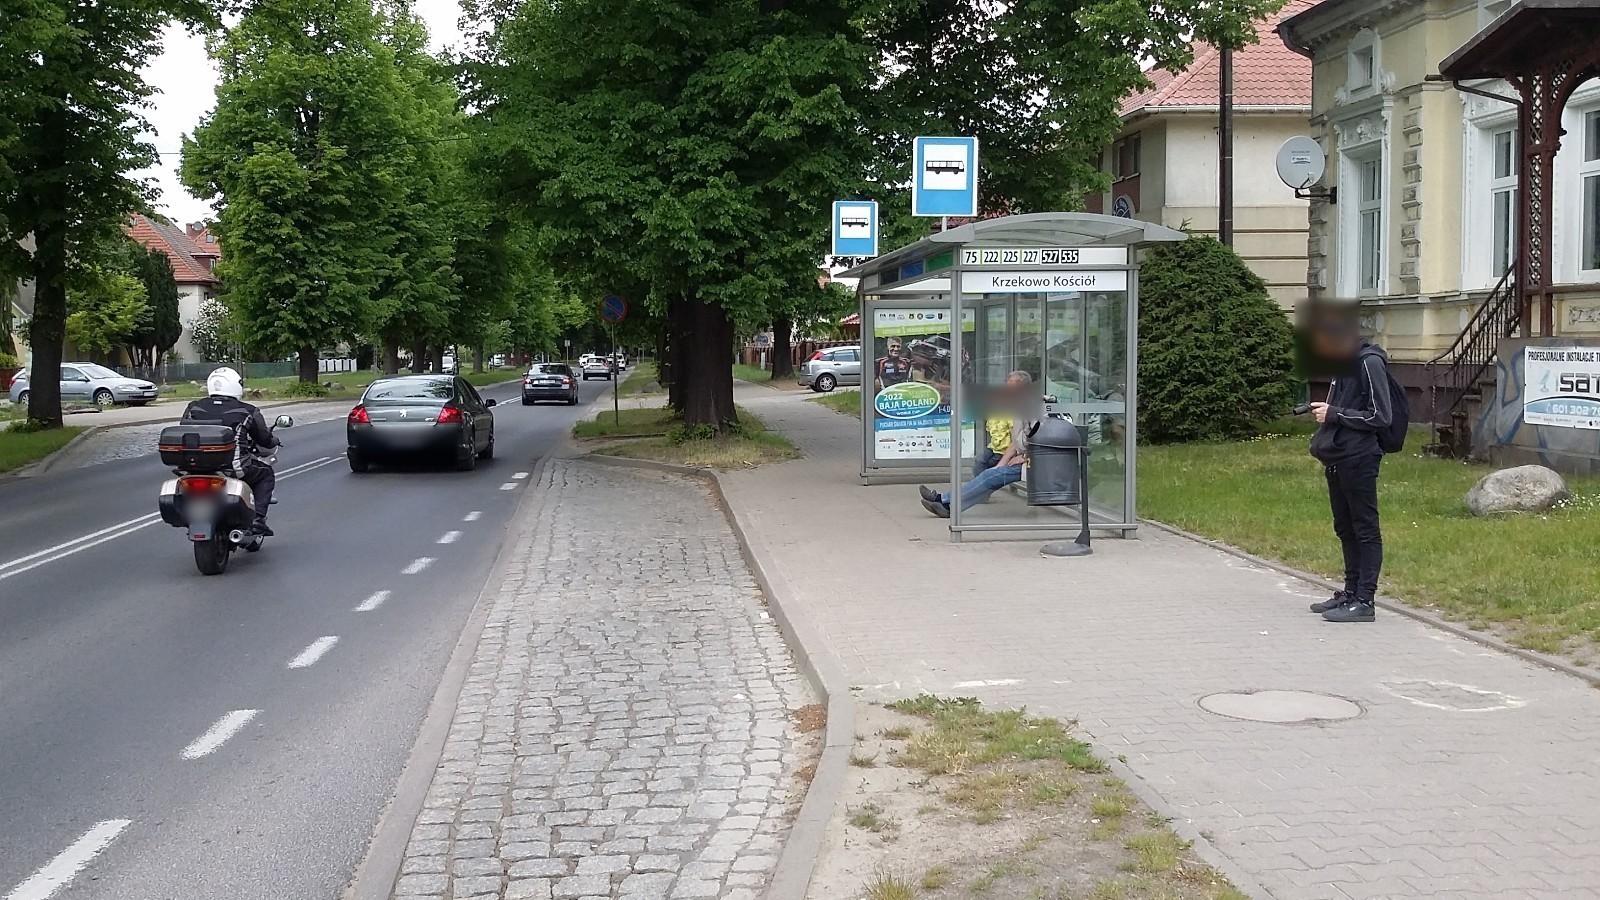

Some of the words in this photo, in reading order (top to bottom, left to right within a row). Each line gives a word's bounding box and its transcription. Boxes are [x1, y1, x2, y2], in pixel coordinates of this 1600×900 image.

[965, 251, 977, 263] 75
[984, 251, 999, 262] 222
[1003, 251, 1018, 262] 225
[1023, 251, 1038, 262] 227
[1042, 250, 1058, 263] 527
[1061, 250, 1078, 263] 535
[992, 276, 1050, 287] Krzekowo
[1053, 275, 1096, 287] Kościół
[883, 393, 903, 401] 2022
[879, 401, 900, 410] BAJA
[902, 398, 936, 408] POLAND
[1552, 403, 1568, 415] 601
[1569, 405, 1589, 416] 302
